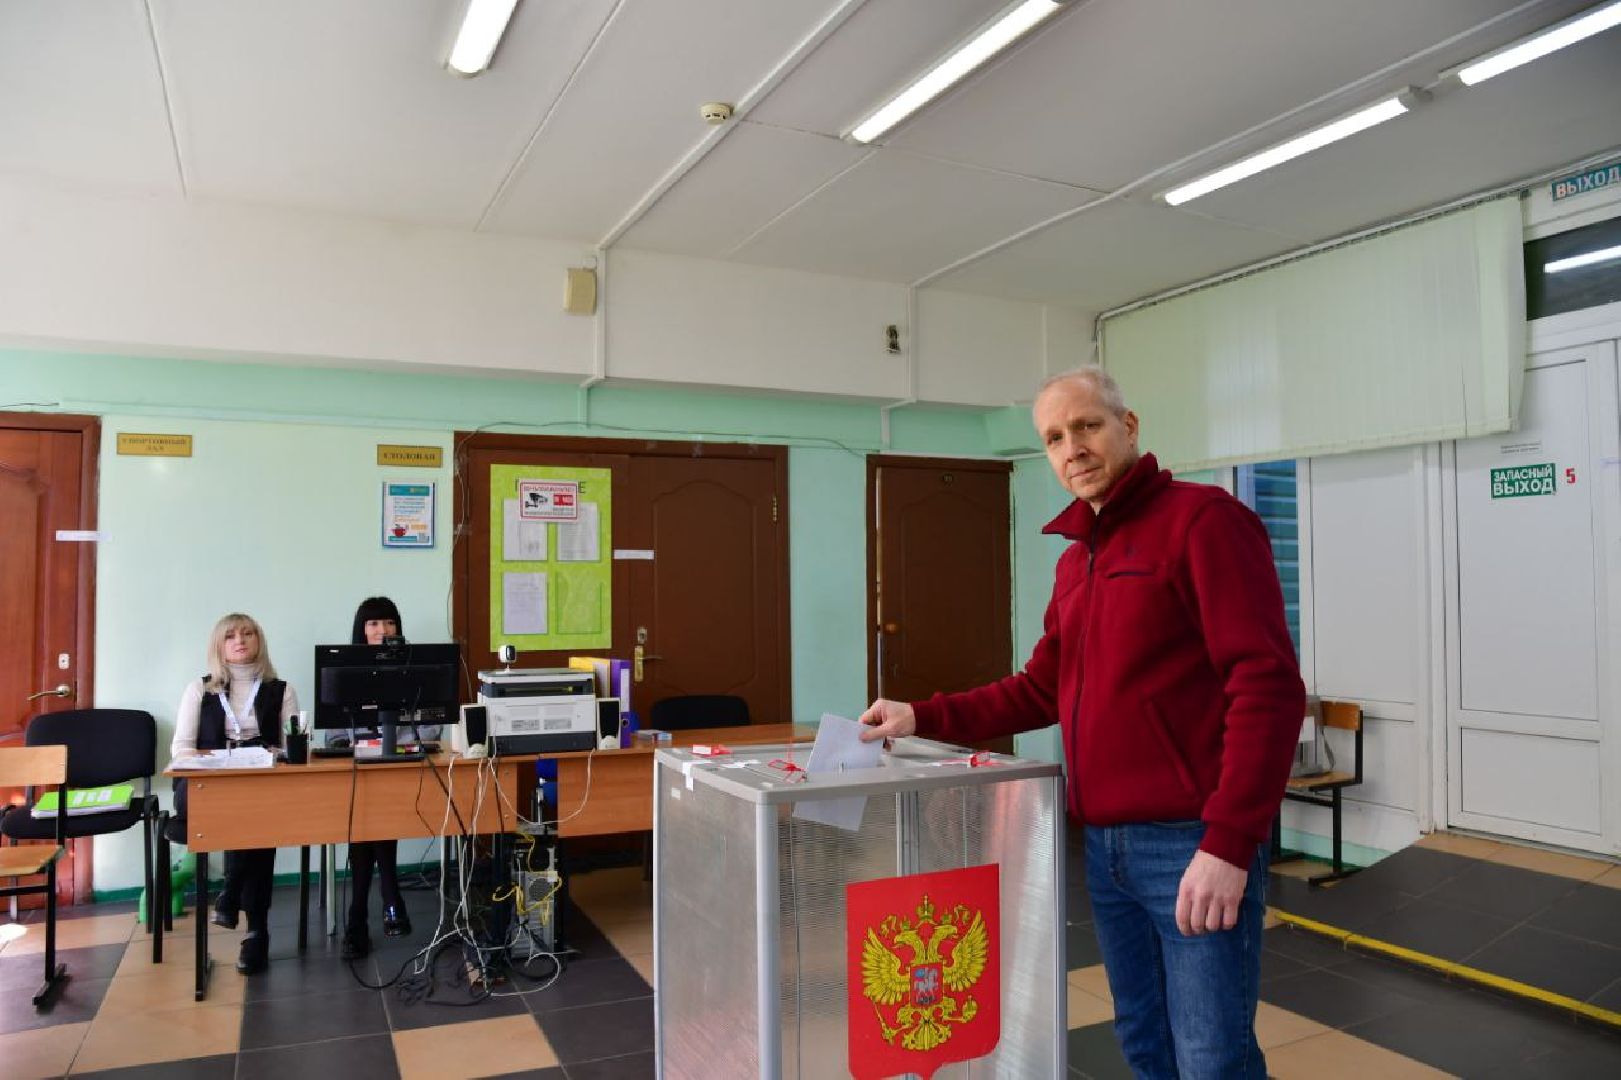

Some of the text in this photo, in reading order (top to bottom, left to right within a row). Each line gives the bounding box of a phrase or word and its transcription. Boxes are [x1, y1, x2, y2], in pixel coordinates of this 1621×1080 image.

[1556, 166, 1620, 198] ВЫХОД
[1493, 464, 1553, 482] ЗАПАСНЫЙ
[1565, 467, 1576, 484] 5
[1493, 478, 1554, 496] ВЫХОД
